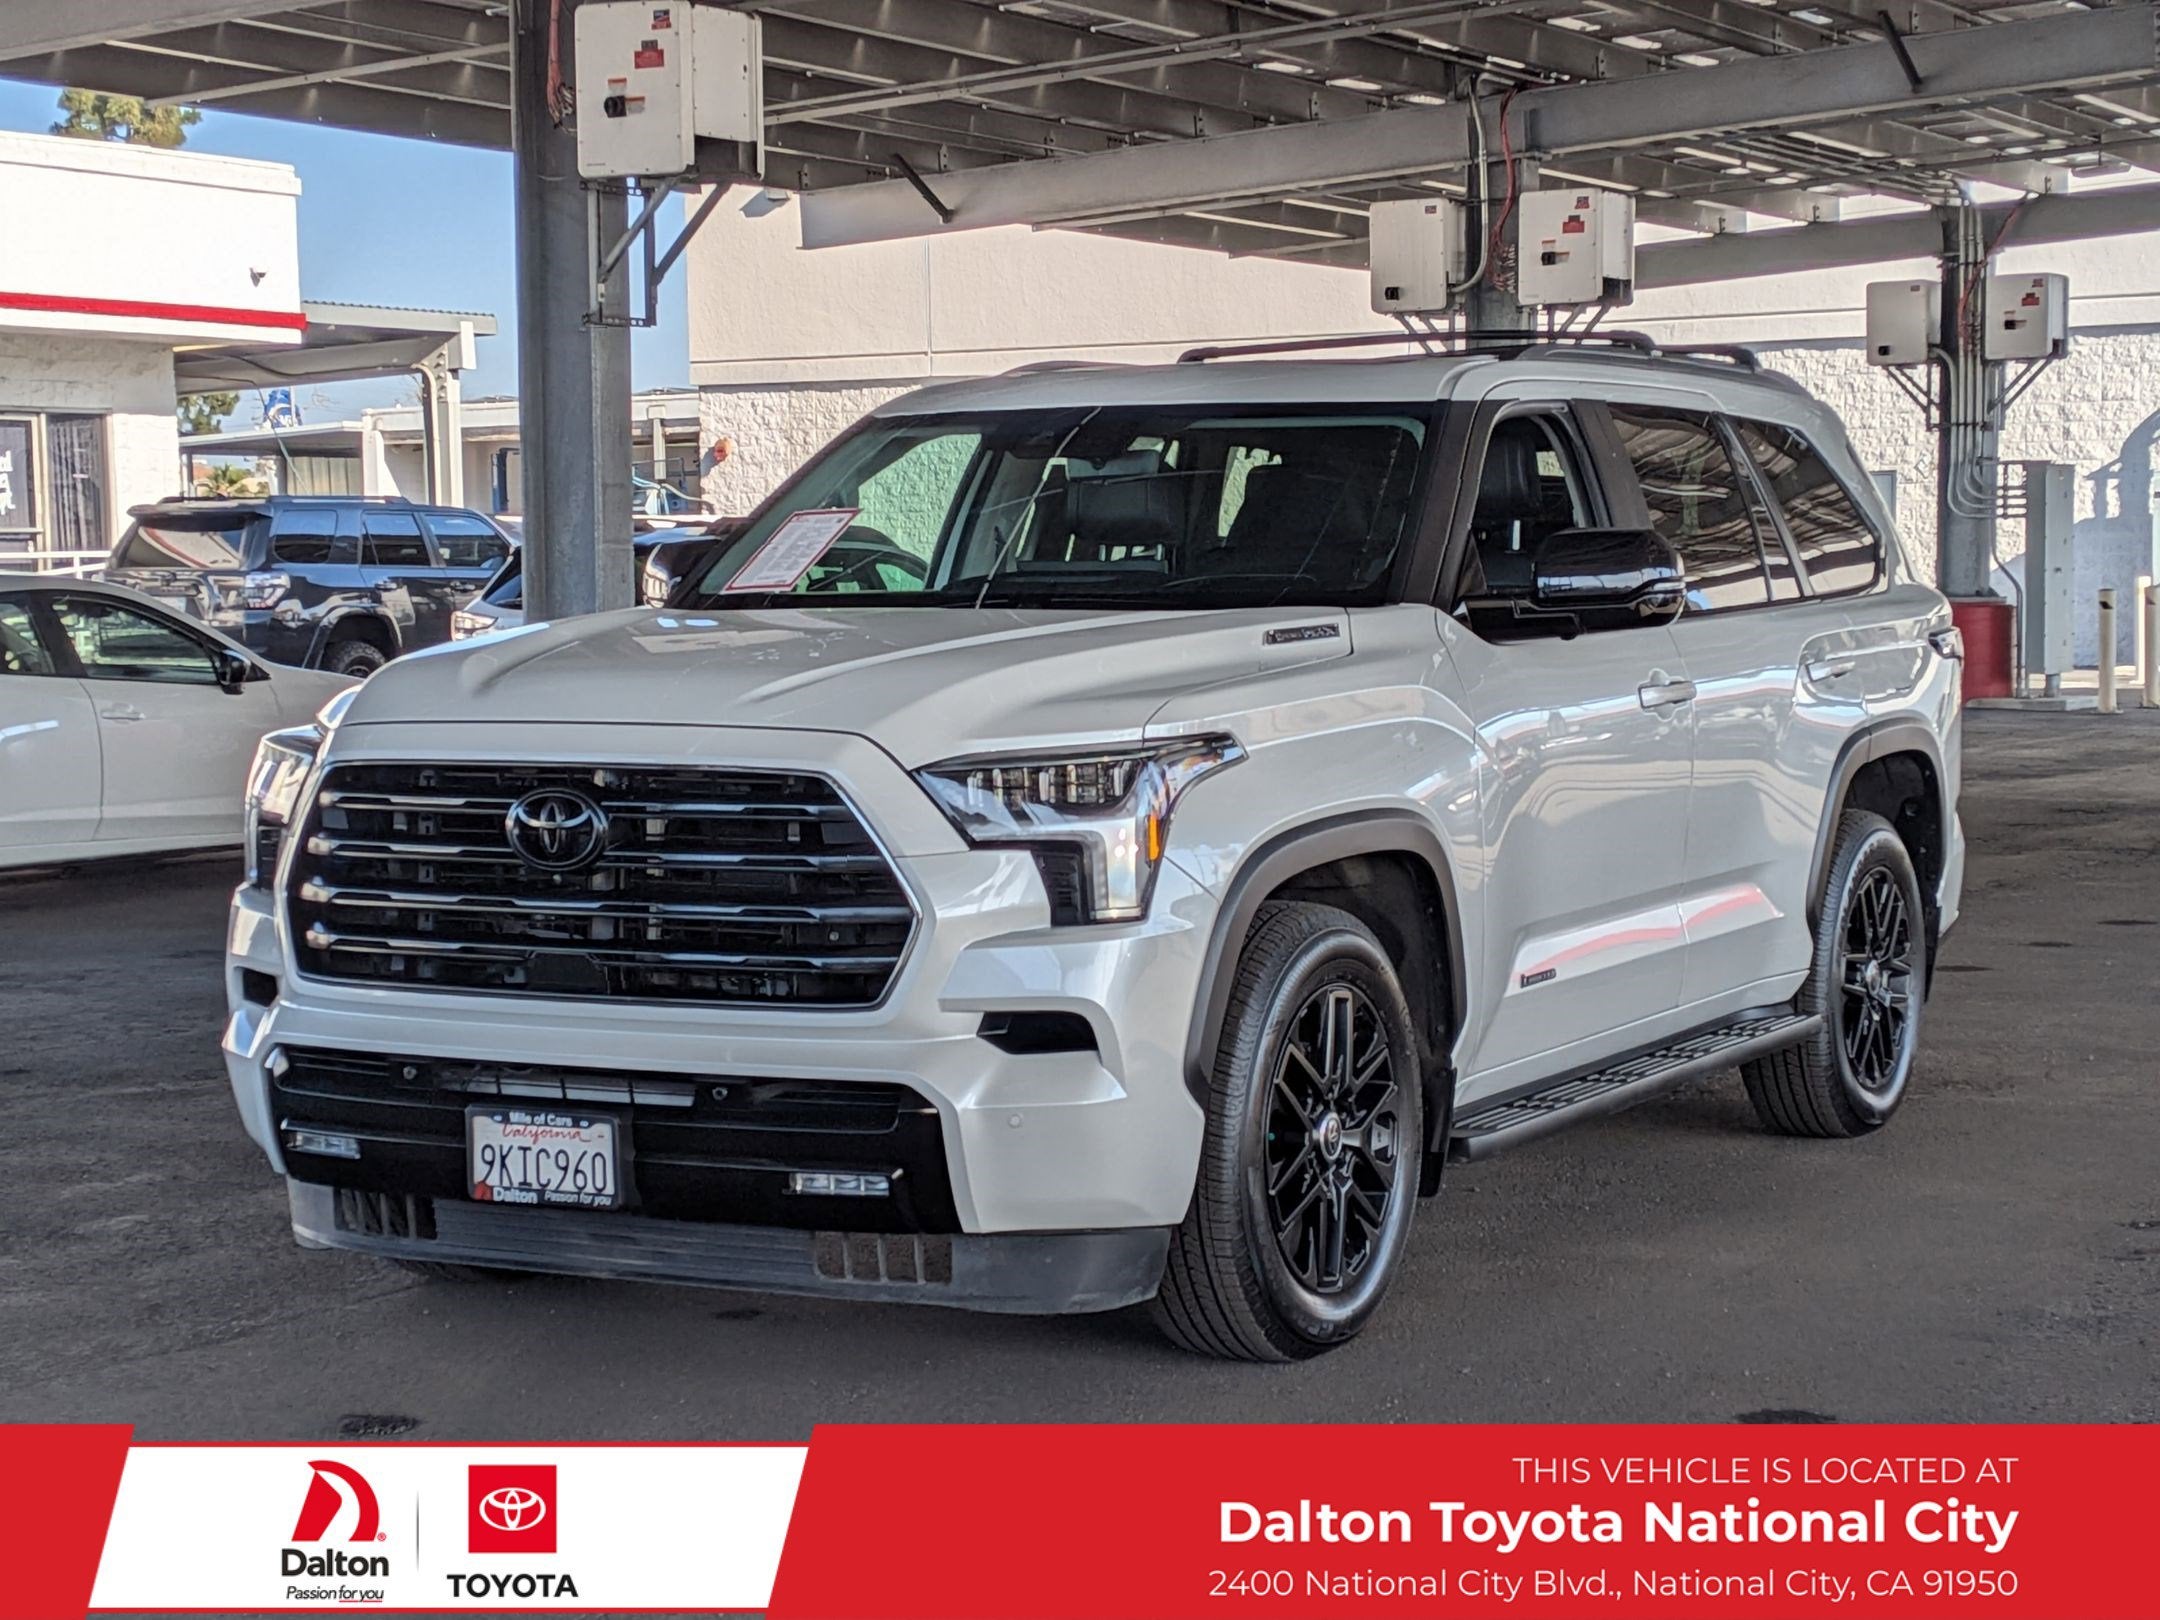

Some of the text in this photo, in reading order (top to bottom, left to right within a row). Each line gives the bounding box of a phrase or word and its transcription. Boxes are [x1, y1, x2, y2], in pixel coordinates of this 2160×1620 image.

[508, 1112, 573, 1127] Mile of Cars
[502, 1124, 591, 1144] California
[481, 1143, 607, 1193] 9KIC960
[493, 1187, 538, 1204] Dalton
[579, 1191, 594, 1204] for
[593, 1195, 612, 1206] you
